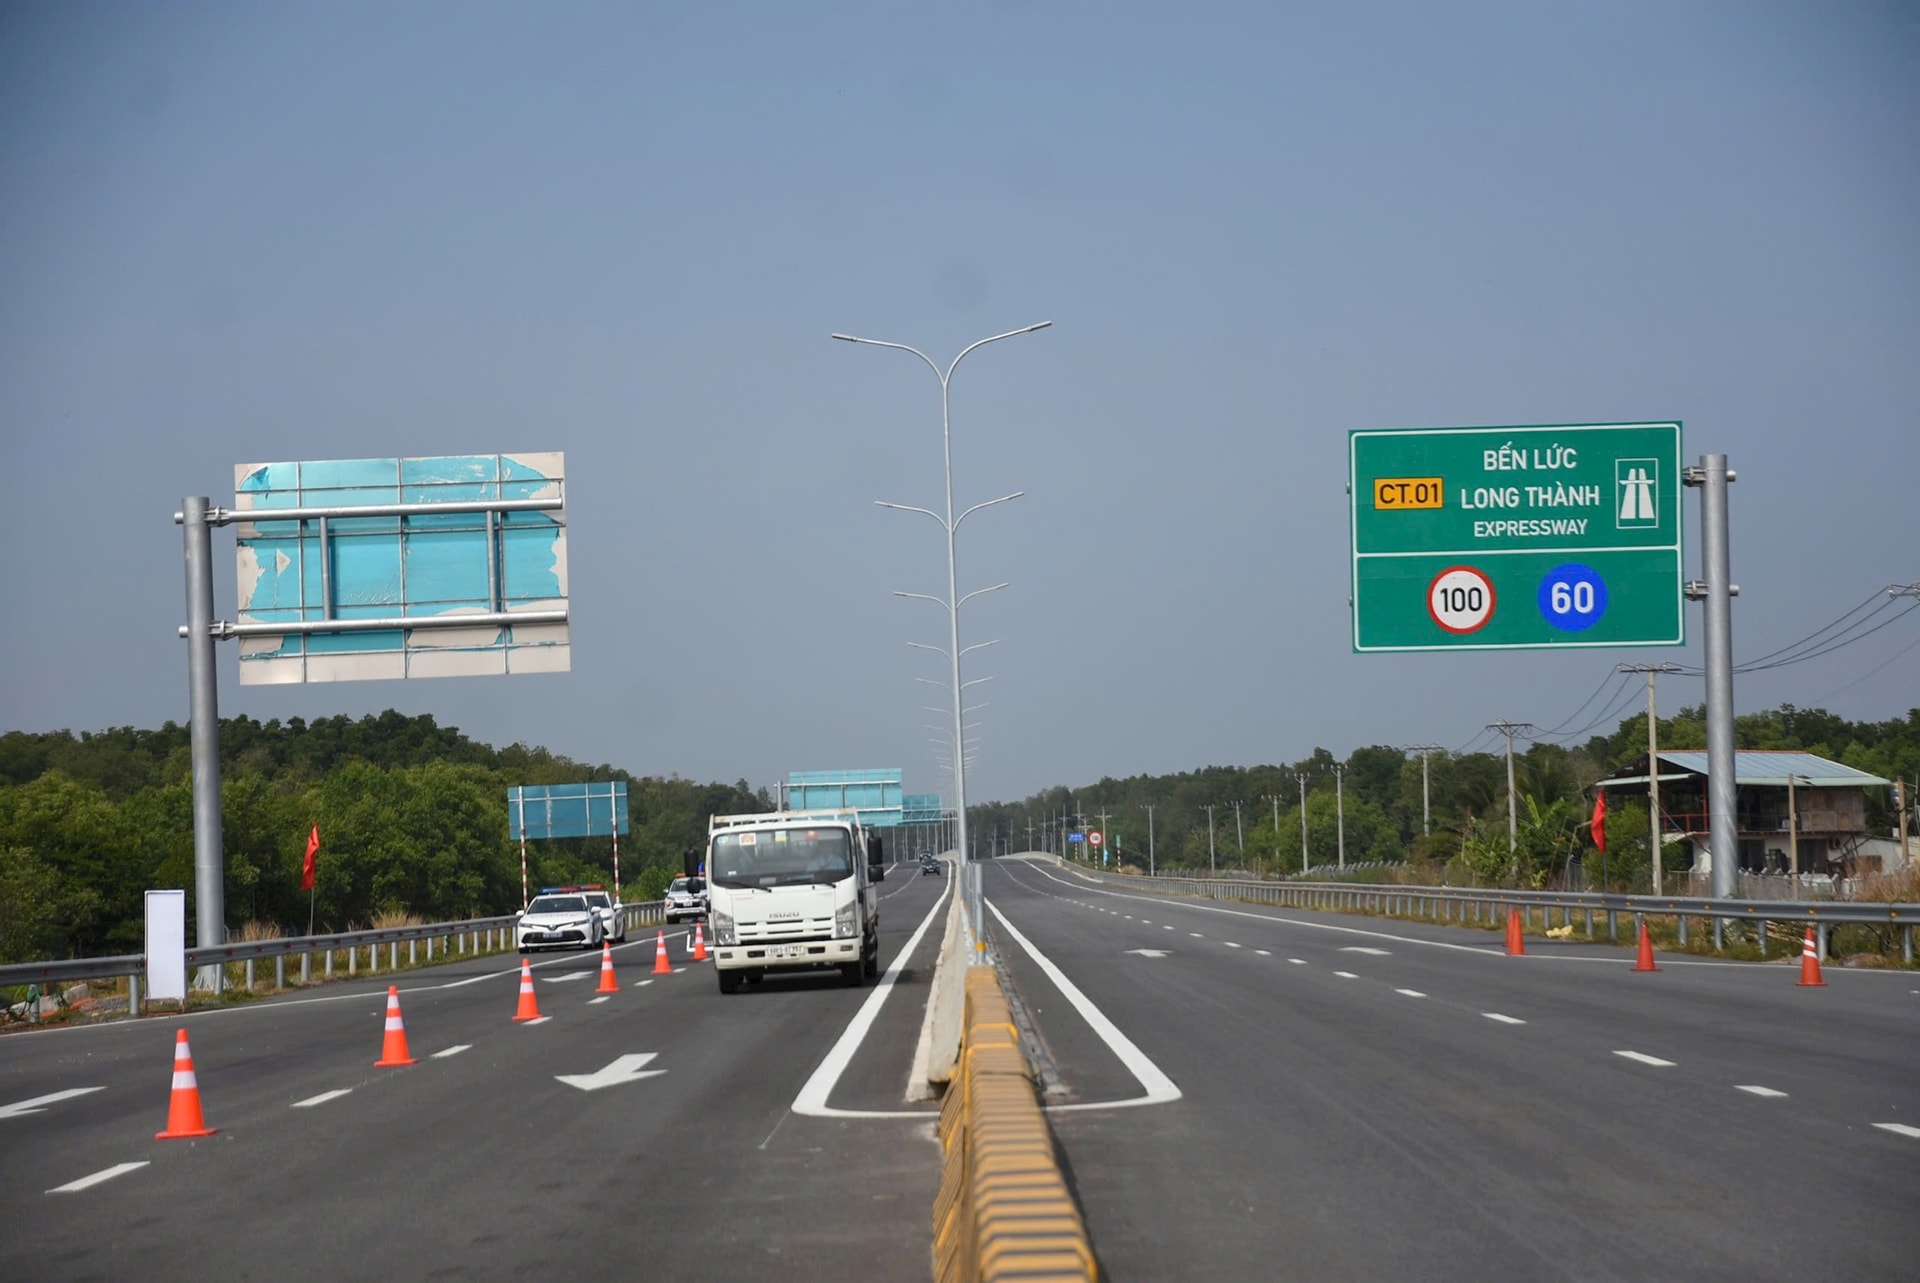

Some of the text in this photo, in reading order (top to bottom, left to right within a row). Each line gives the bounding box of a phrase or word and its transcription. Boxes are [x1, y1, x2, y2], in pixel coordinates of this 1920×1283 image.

[1483, 441, 1577, 471] BẾN LỨC
[1379, 482, 1439, 504] CT.01
[1461, 481, 1600, 509] LONG THÀNH
[1474, 519, 1588, 537] EXPRESSWAY
[1440, 587, 1482, 613] 100
[1551, 581, 1594, 614] 60
